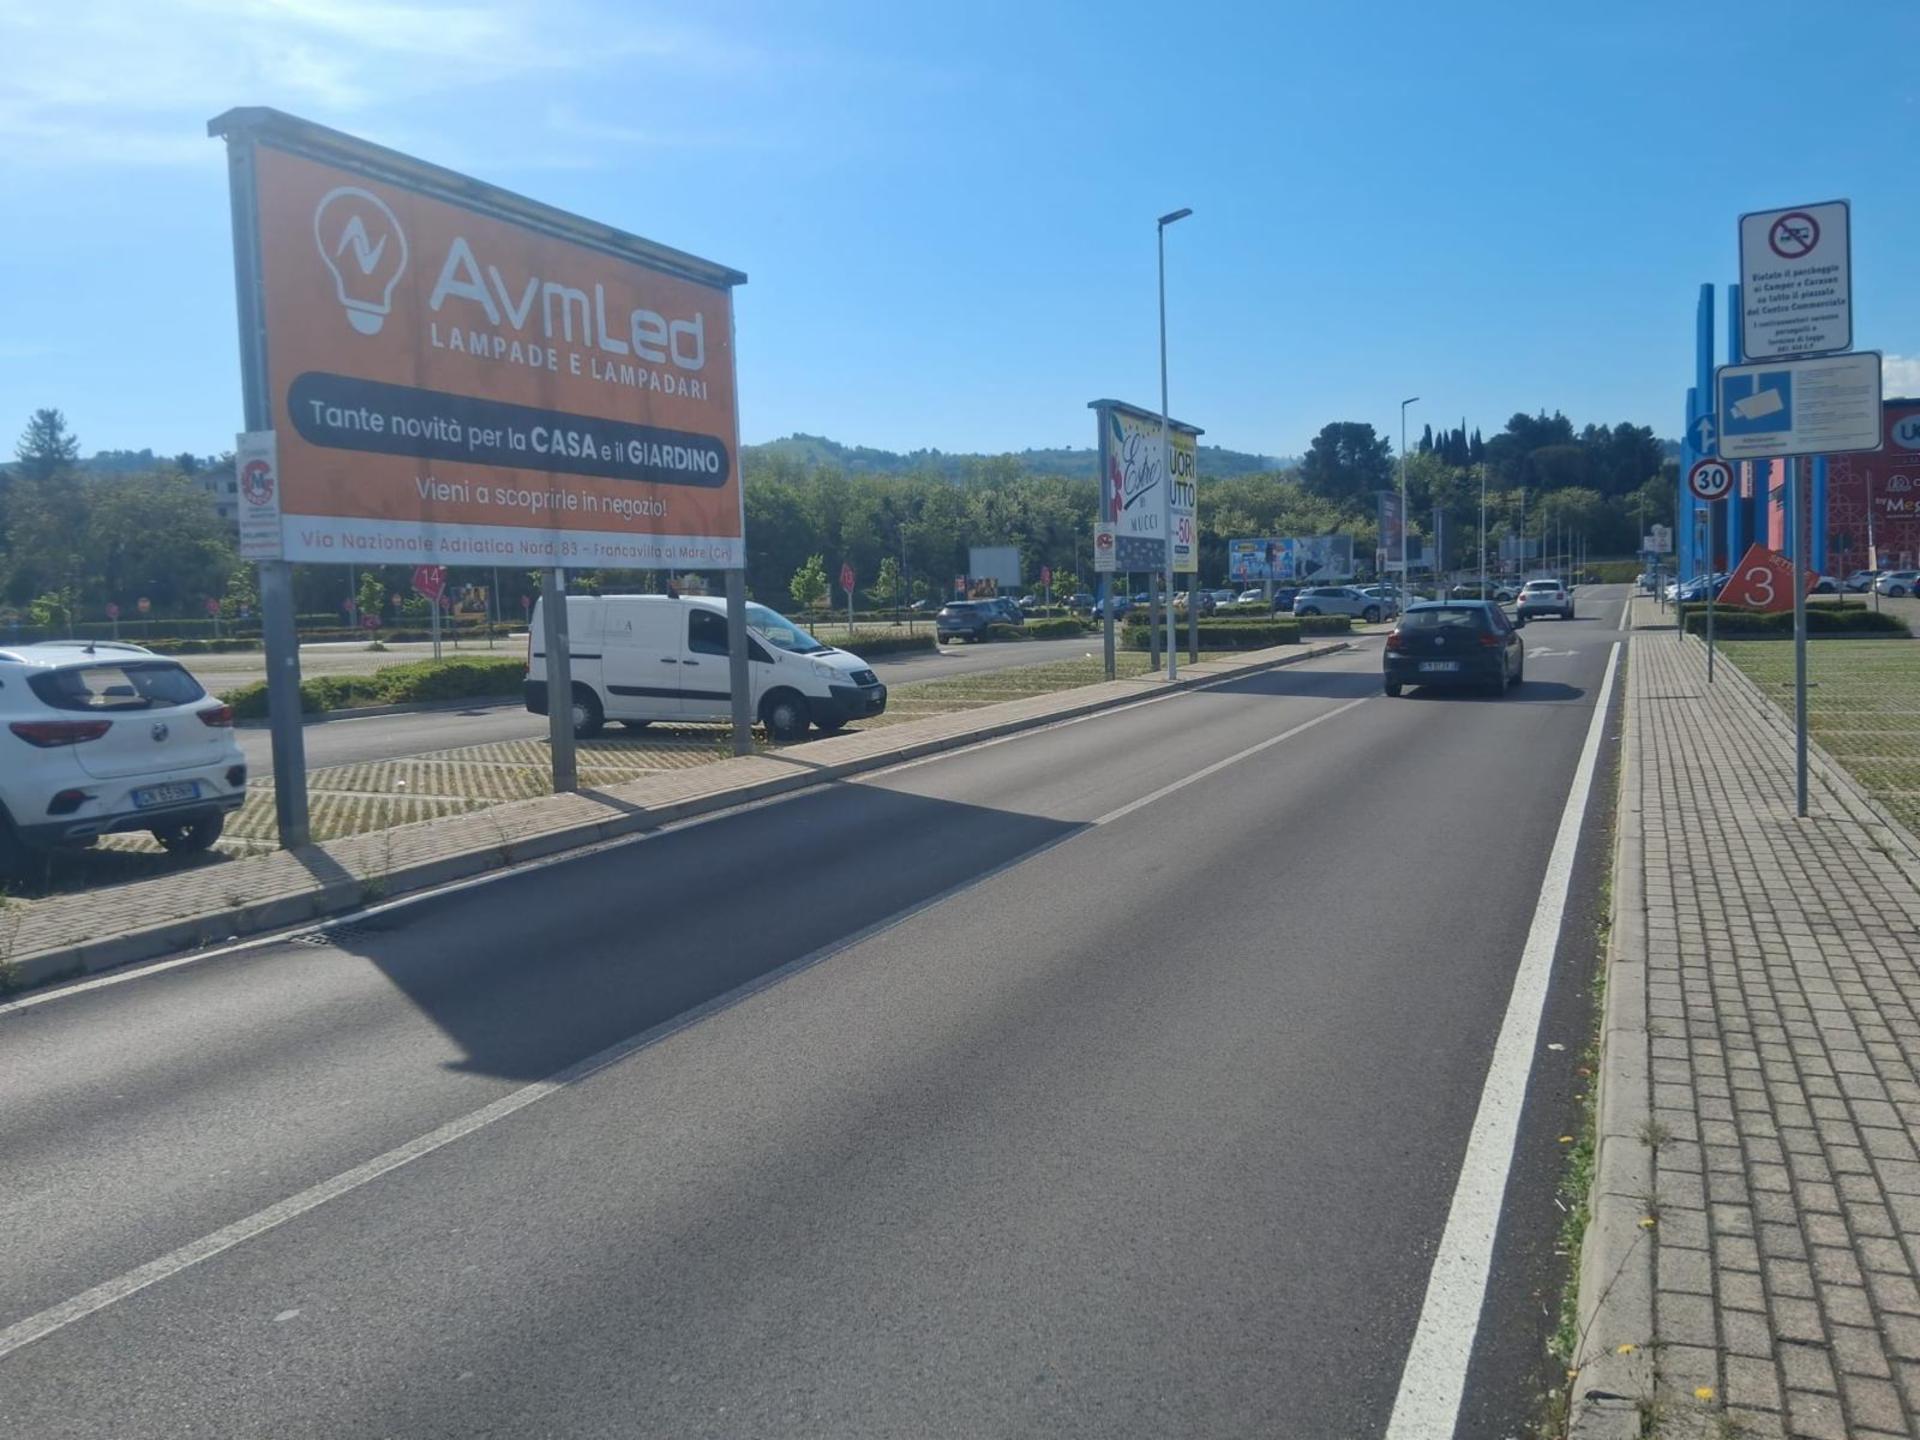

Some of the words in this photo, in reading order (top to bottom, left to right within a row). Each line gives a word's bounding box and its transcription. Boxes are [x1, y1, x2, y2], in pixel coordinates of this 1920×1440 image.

[1764, 281, 1794, 292] Camper
[430, 236, 705, 371] AvmLed
[1762, 304, 1789, 315] Centro
[1791, 298, 1846, 312] Commerciale
[431, 323, 558, 371] LAMPADE
[570, 353, 582, 376] E
[591, 358, 708, 400] LAMPADARI
[309, 399, 385, 432] Tante
[391, 415, 463, 443] novità
[468, 426, 503, 451] per
[508, 427, 526, 451] la
[530, 426, 598, 460] CASA
[601, 445, 612, 461] e
[614, 442, 624, 463] il
[628, 440, 720, 474] GIARDINO
[1699, 468, 1725, 490] 30
[415, 477, 470, 502] Vieni
[476, 487, 489, 504] a
[495, 488, 578, 514] scoprirle
[582, 489, 598, 512] in
[602, 496, 668, 521] negozio!
[301, 531, 334, 548] Via
[342, 532, 434, 552] Nazionale
[440, 537, 514, 554] Adriatica
[562, 542, 577, 556] 83
[594, 543, 662, 559] Francavilla
[666, 544, 676, 558] al
[680, 546, 705, 559] Mare
[422, 569, 440, 585] 14
[1744, 567, 1775, 606] 3
